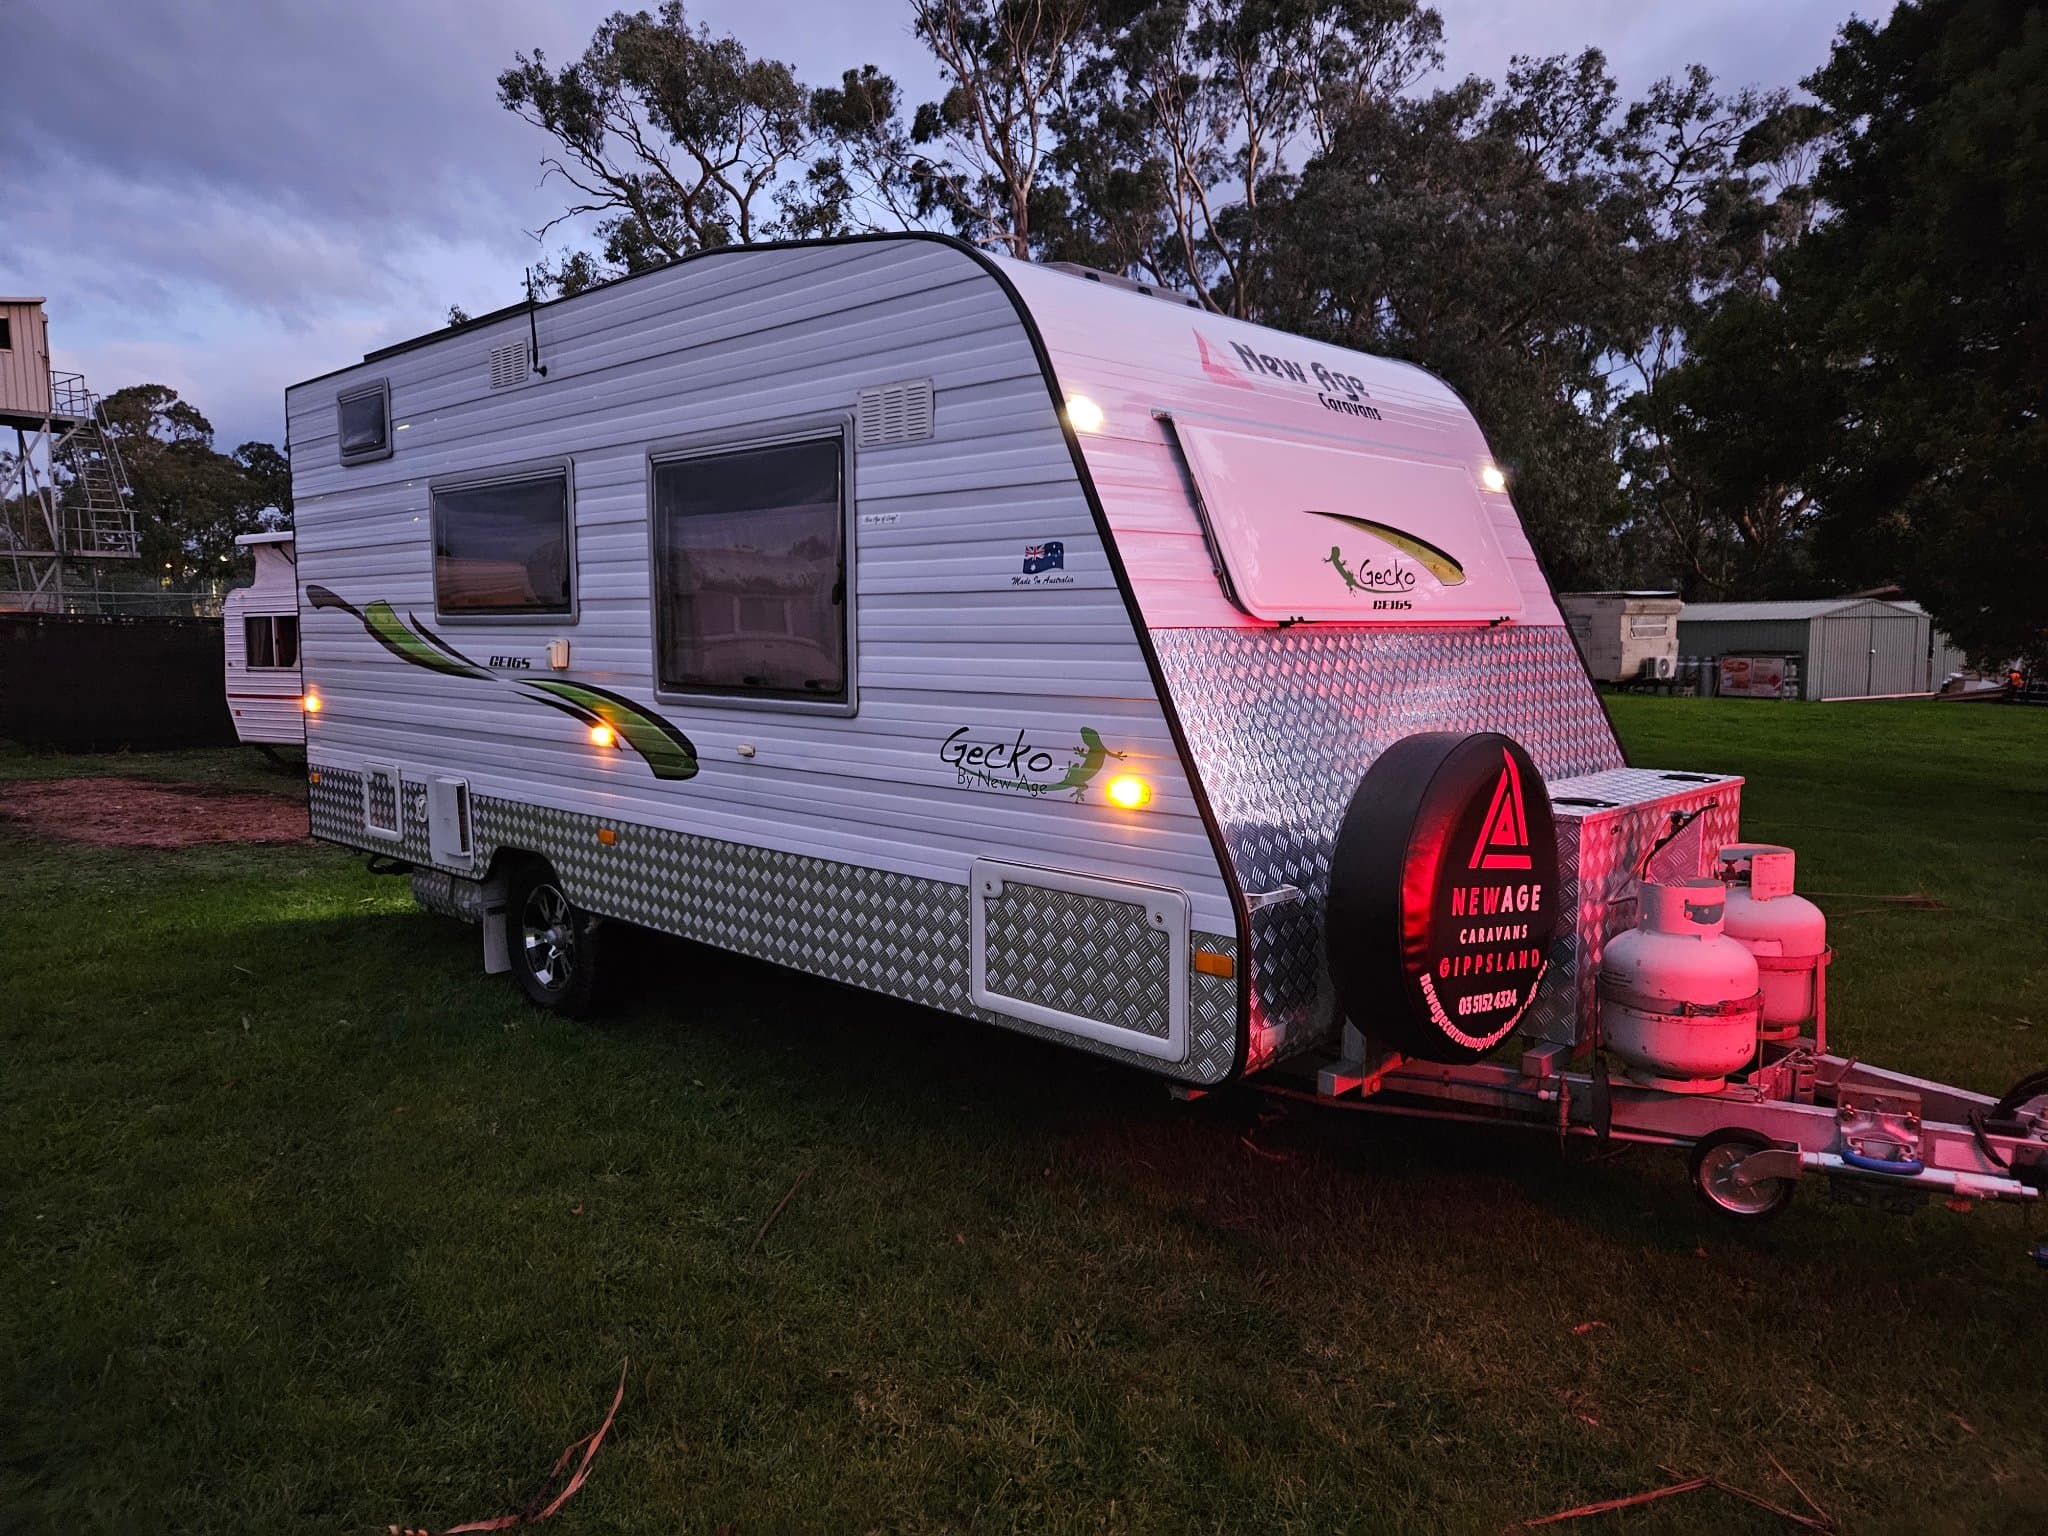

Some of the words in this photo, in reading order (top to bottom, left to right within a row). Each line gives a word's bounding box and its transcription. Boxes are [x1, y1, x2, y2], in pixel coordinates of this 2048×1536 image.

[1228, 340, 1308, 384] New
[1310, 362, 1370, 401] Age
[1317, 392, 1383, 421] Caravans
[1011, 576, 1031, 586] Made
[1042, 575, 1074, 585] Australia
[1359, 558, 1416, 590] Gecko
[940, 726, 1053, 778] Gecko
[957, 767, 974, 790] By
[977, 769, 1012, 790] New
[1015, 774, 1048, 798] Age
[1459, 924, 1528, 945] CARAVANS
[1439, 948, 1540, 978] GIPPSLAND
